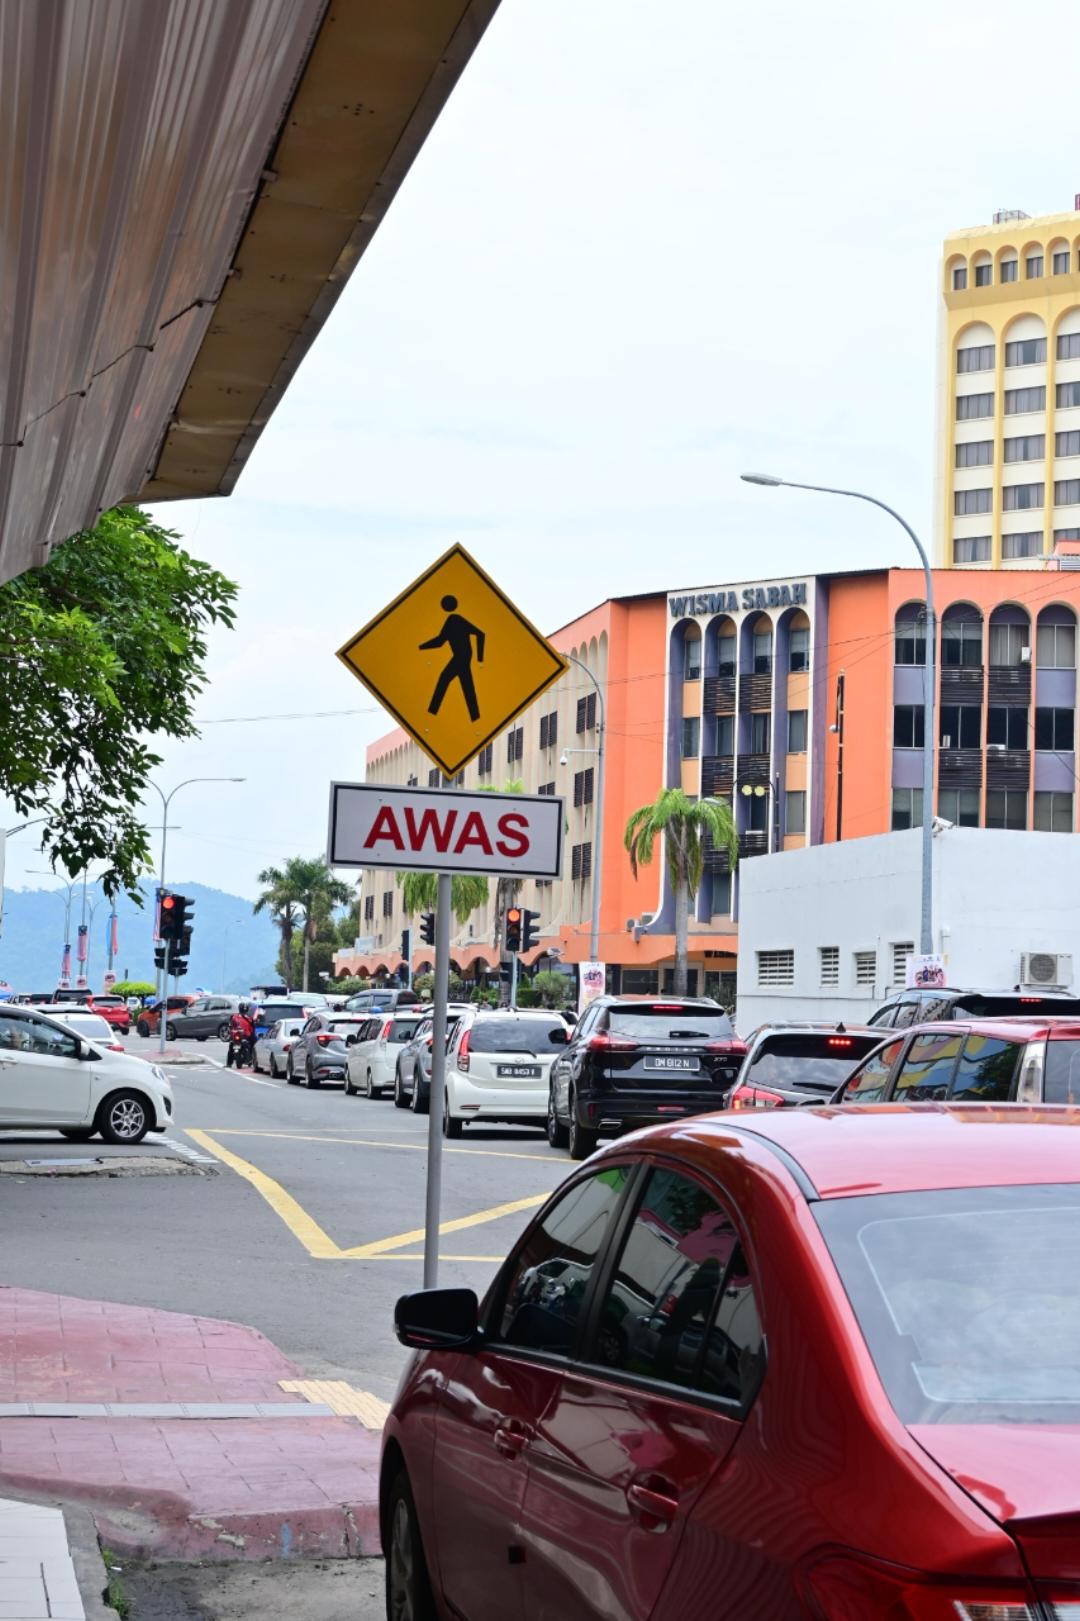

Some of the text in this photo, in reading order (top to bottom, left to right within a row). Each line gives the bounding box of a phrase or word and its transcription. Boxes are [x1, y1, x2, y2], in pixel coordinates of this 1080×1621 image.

[669, 583, 807, 618] WISMA SABAH
[363, 805, 530, 858] AWAS
